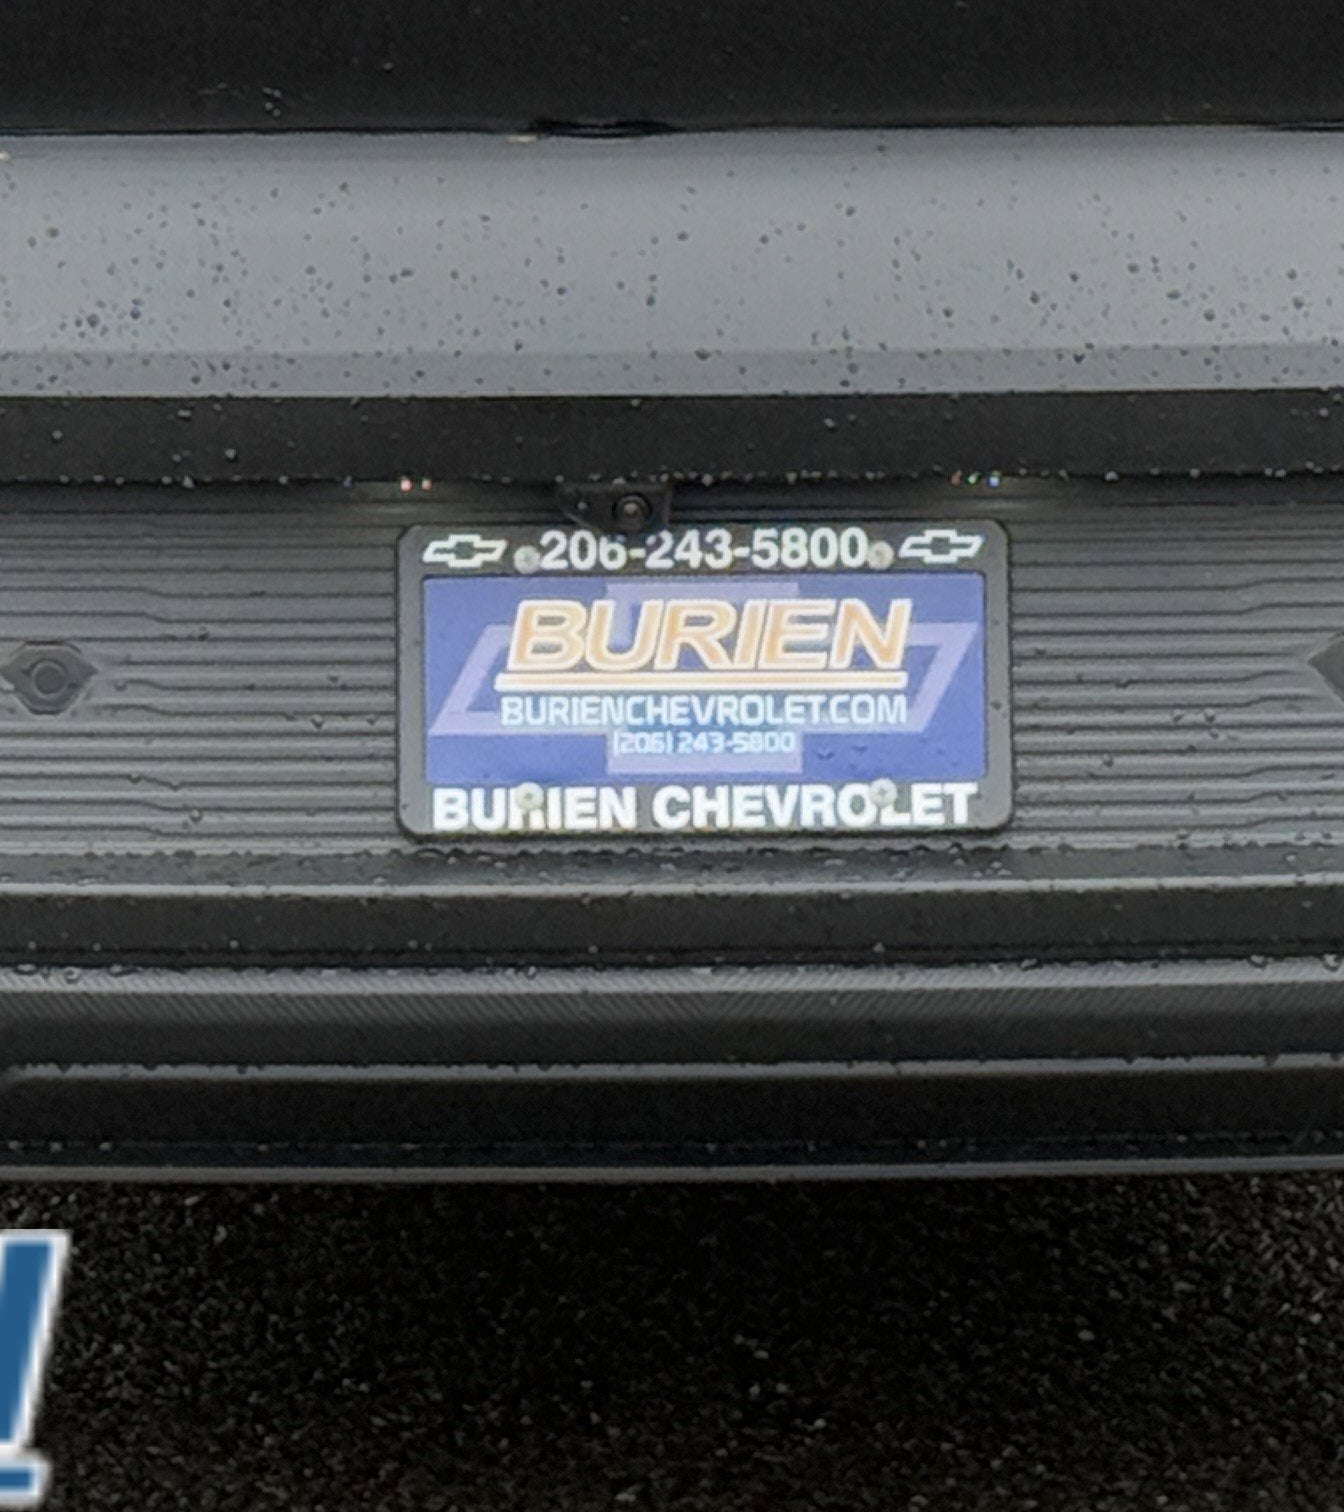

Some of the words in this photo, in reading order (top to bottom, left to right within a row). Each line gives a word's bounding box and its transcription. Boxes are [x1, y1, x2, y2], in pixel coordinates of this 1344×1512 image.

[539, 527, 869, 571] 206-243-5800
[508, 598, 912, 672] BURIEN
[500, 694, 907, 727] BURIENCHEVROLET.COM
[678, 732, 796, 754] 243-5800
[433, 785, 636, 830] BURIEN
[653, 783, 978, 828] CHEVROLET
